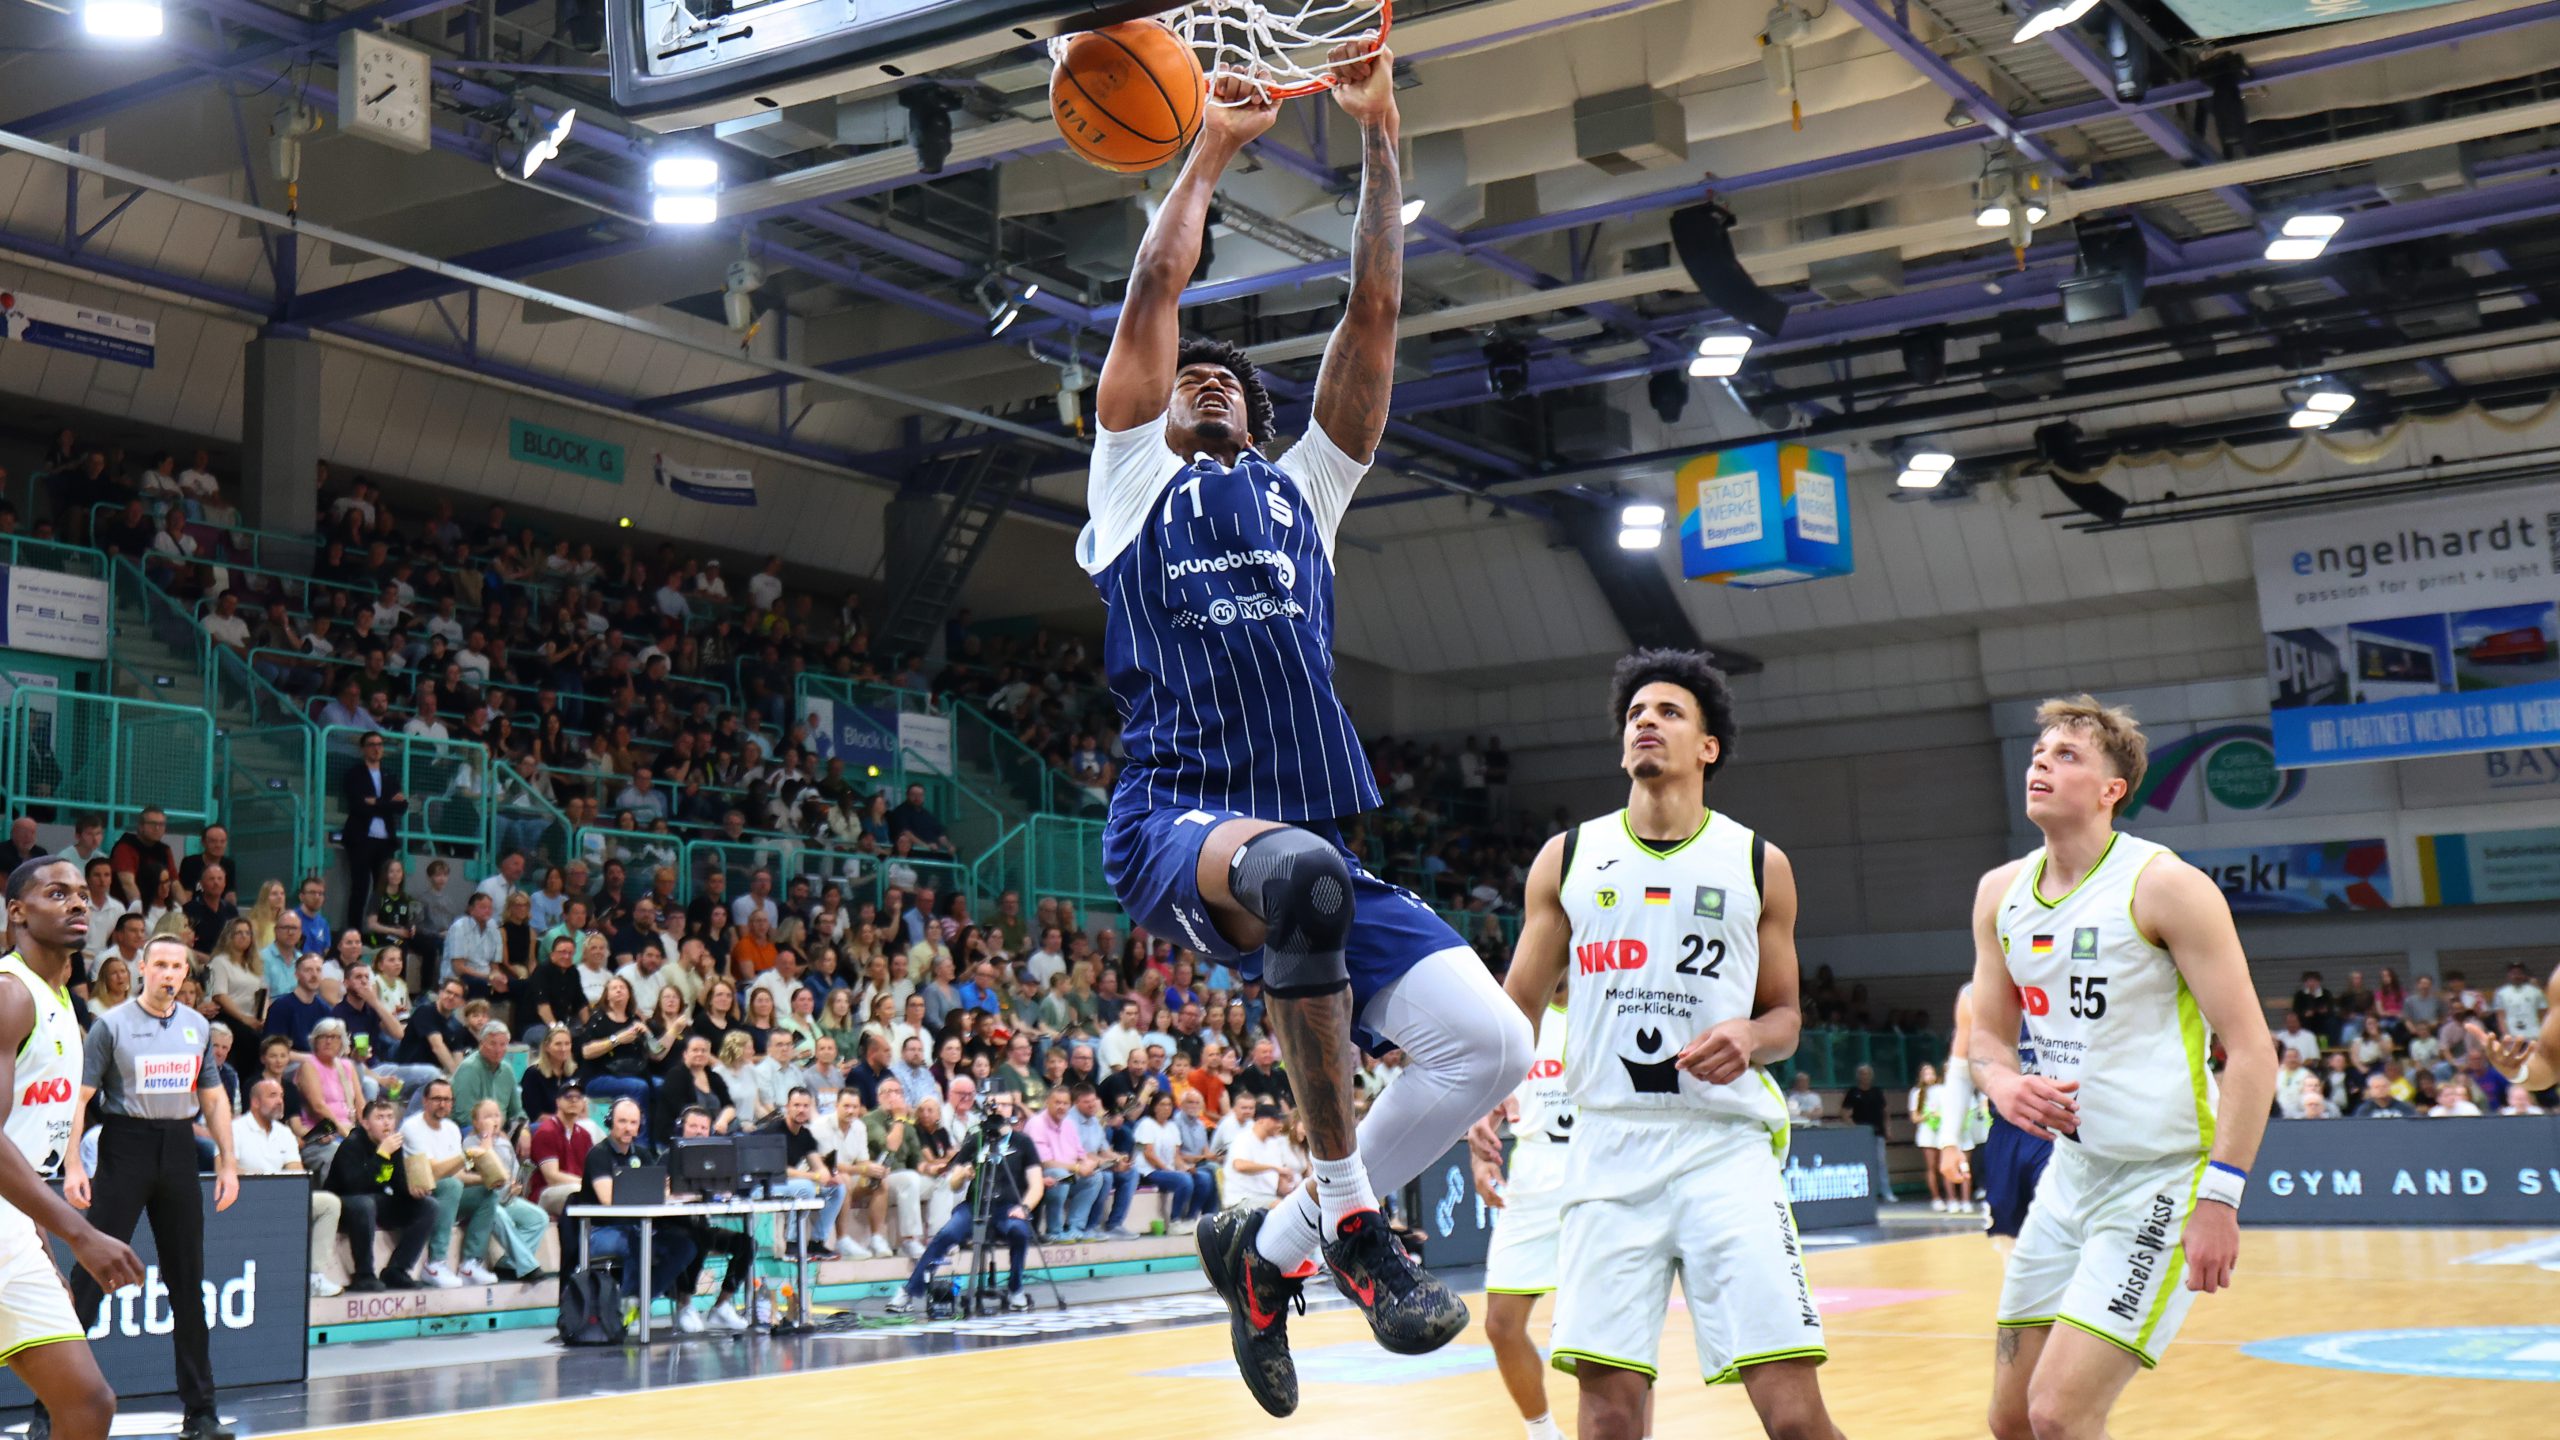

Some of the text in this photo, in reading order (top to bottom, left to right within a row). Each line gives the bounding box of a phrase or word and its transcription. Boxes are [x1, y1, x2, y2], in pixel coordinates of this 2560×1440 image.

[523, 430, 613, 472] BLOCK G
[1703, 479, 1755, 505] STADT
[1799, 477, 1832, 498] STADT
[1705, 500, 1756, 523] WERKE
[1800, 500, 1834, 519] WERKE
[1707, 521, 1759, 542] Bayreuth
[2292, 516, 2536, 578] engelhardt
[2295, 584, 2370, 605] passion
[2378, 579, 2407, 594] for
[2419, 570, 2467, 592] print
[2493, 562, 2540, 583] light
[843, 725, 881, 750] Block
[2340, 712, 2411, 748] PARTNER
[2413, 708, 2463, 741] WENN
[1576, 934, 1726, 980] NKD 22
[1605, 988, 1704, 1006] Medikamente-
[2069, 975, 2108, 1020] 55
[1617, 1002, 1693, 1020] per-Klick.de
[144, 1060, 191, 1077] junited
[144, 1077, 190, 1089] AUTOGLAS
[2268, 1168, 2362, 1197] GYM
[2391, 1168, 2488, 1196] AND
[2108, 1194, 2175, 1322] Maisel's Weisse
[347, 1294, 427, 1319] BLOCK H
[1790, 1261, 1820, 1328] Maisel's
